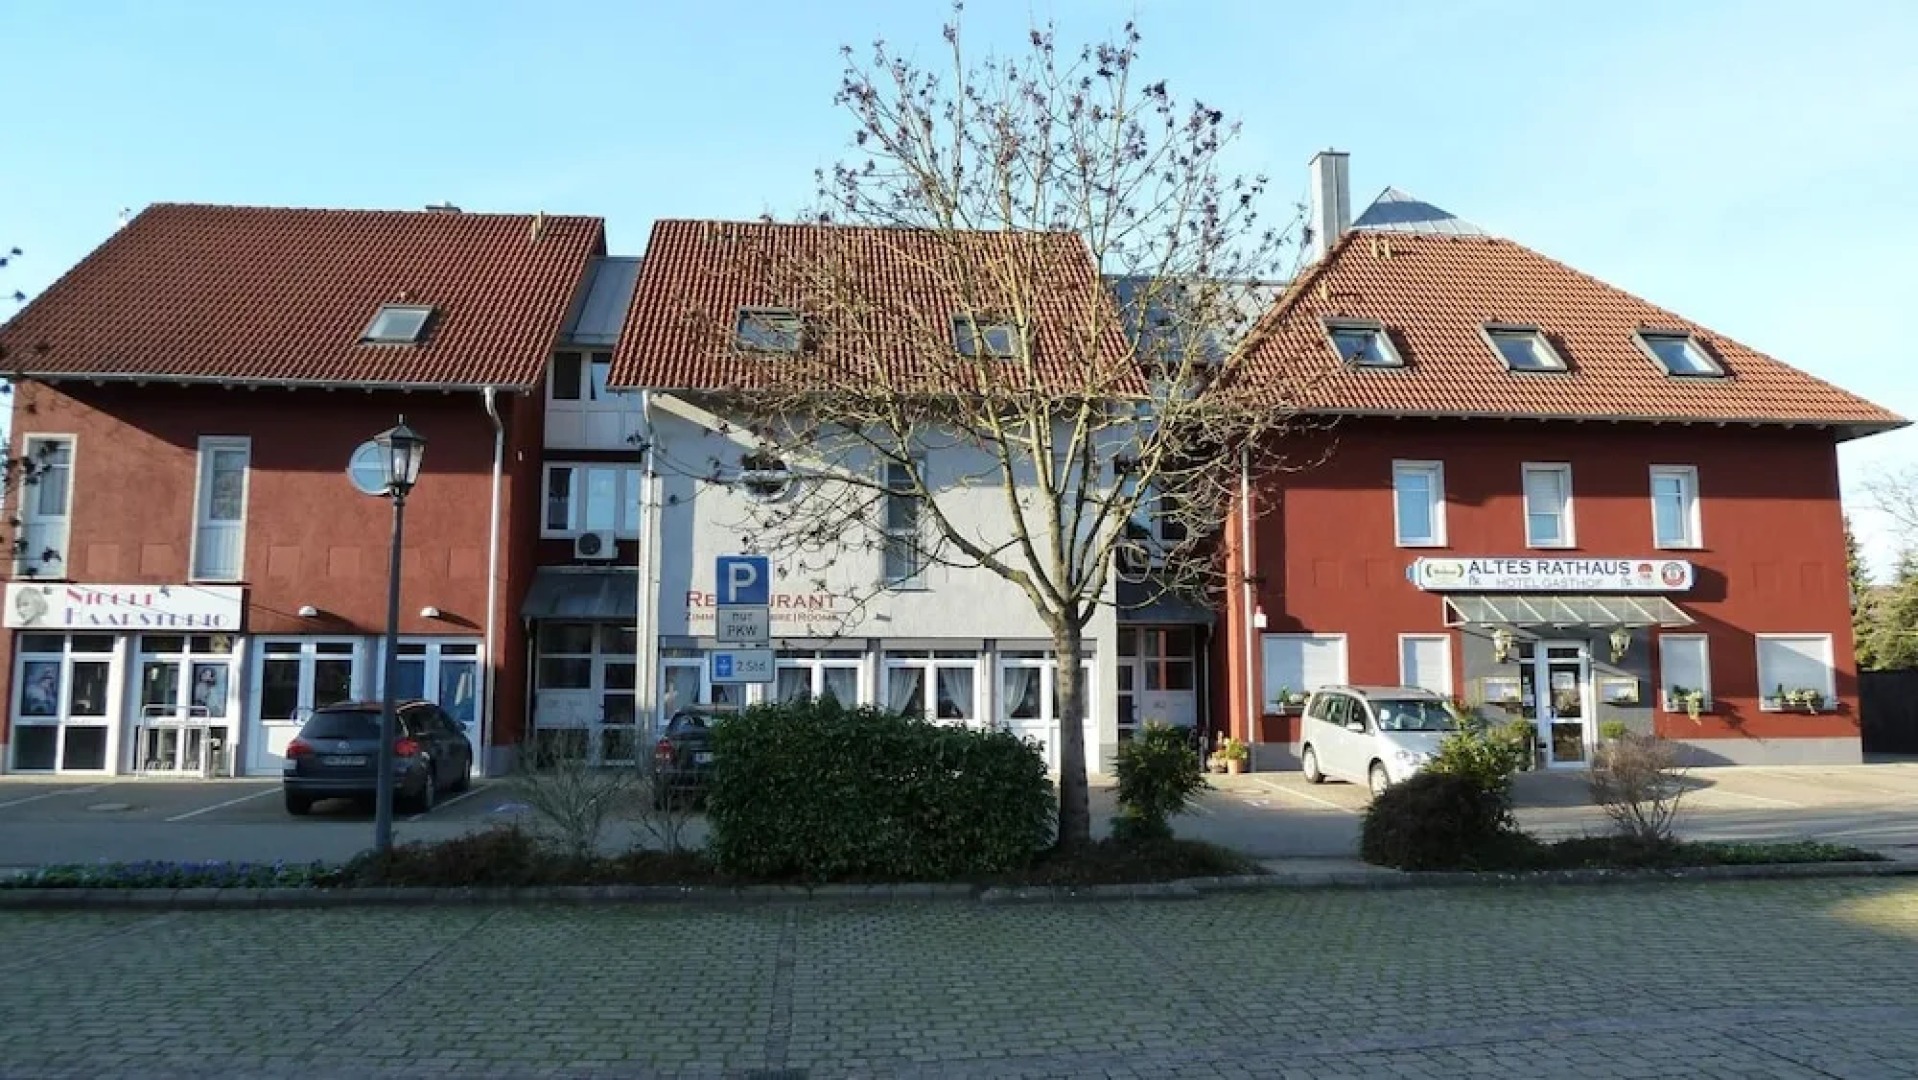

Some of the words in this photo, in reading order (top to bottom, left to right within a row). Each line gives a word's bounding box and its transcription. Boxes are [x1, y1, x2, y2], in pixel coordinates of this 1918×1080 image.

[1469, 561, 1531, 574] ALTES
[1537, 561, 1631, 575] RATHAUS
[728, 562, 757, 602] P
[1496, 577, 1538, 587] HOTEL
[686, 590, 837, 609] RERANT
[727, 624, 758, 637] PKW
